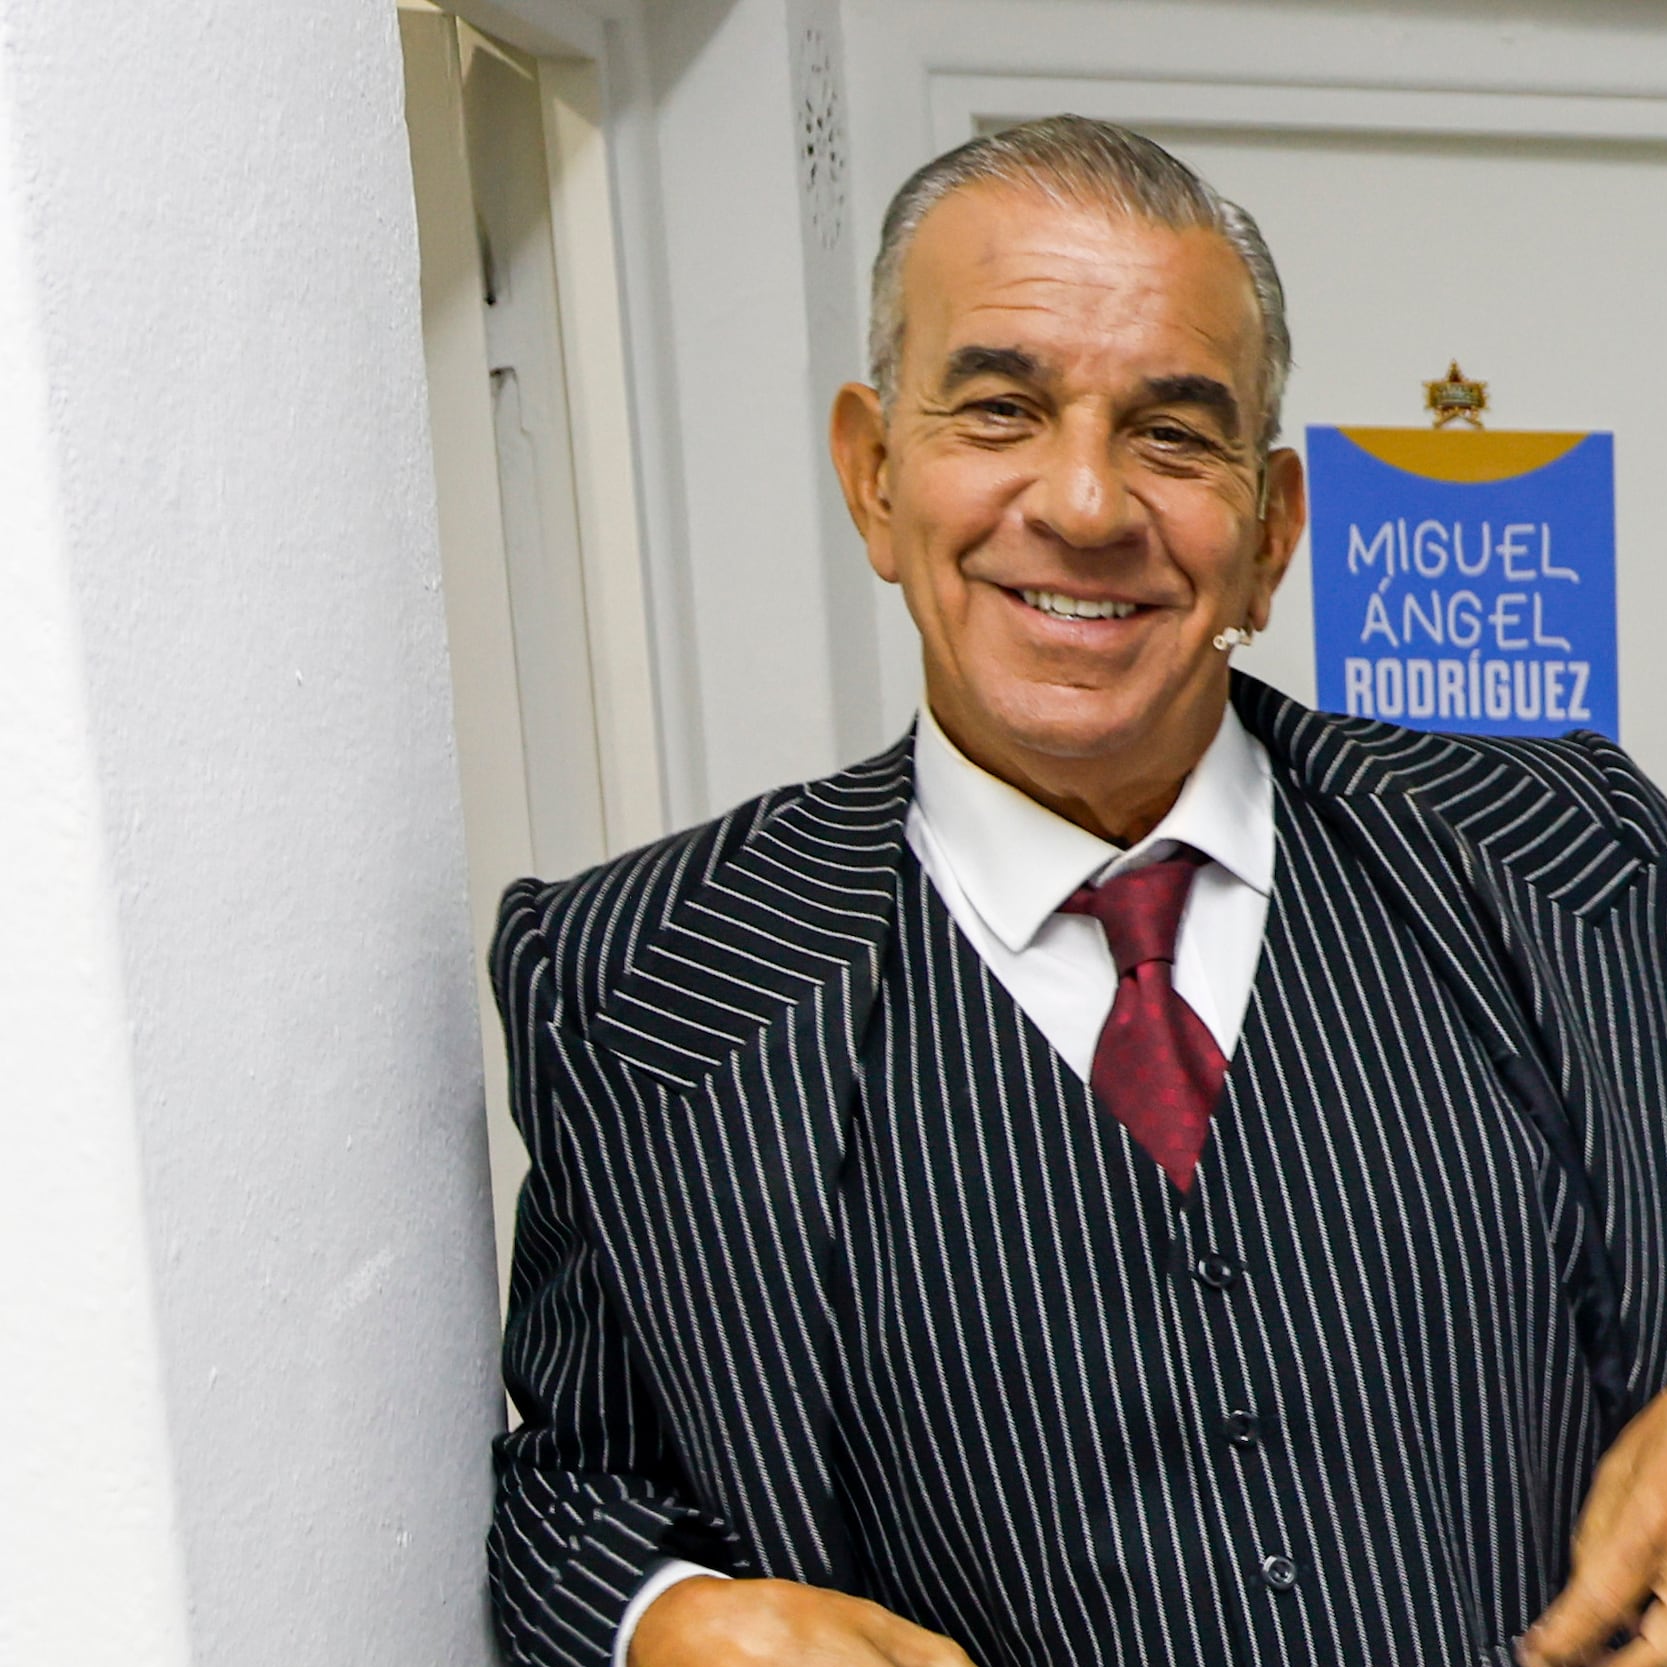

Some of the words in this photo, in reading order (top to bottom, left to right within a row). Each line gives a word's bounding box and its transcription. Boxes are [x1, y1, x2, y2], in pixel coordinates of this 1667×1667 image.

[1347, 517, 1580, 584] MIGUEL
[1360, 576, 1572, 652] ÁNGEL
[1344, 649, 1592, 720] RODRÍGUEZ
